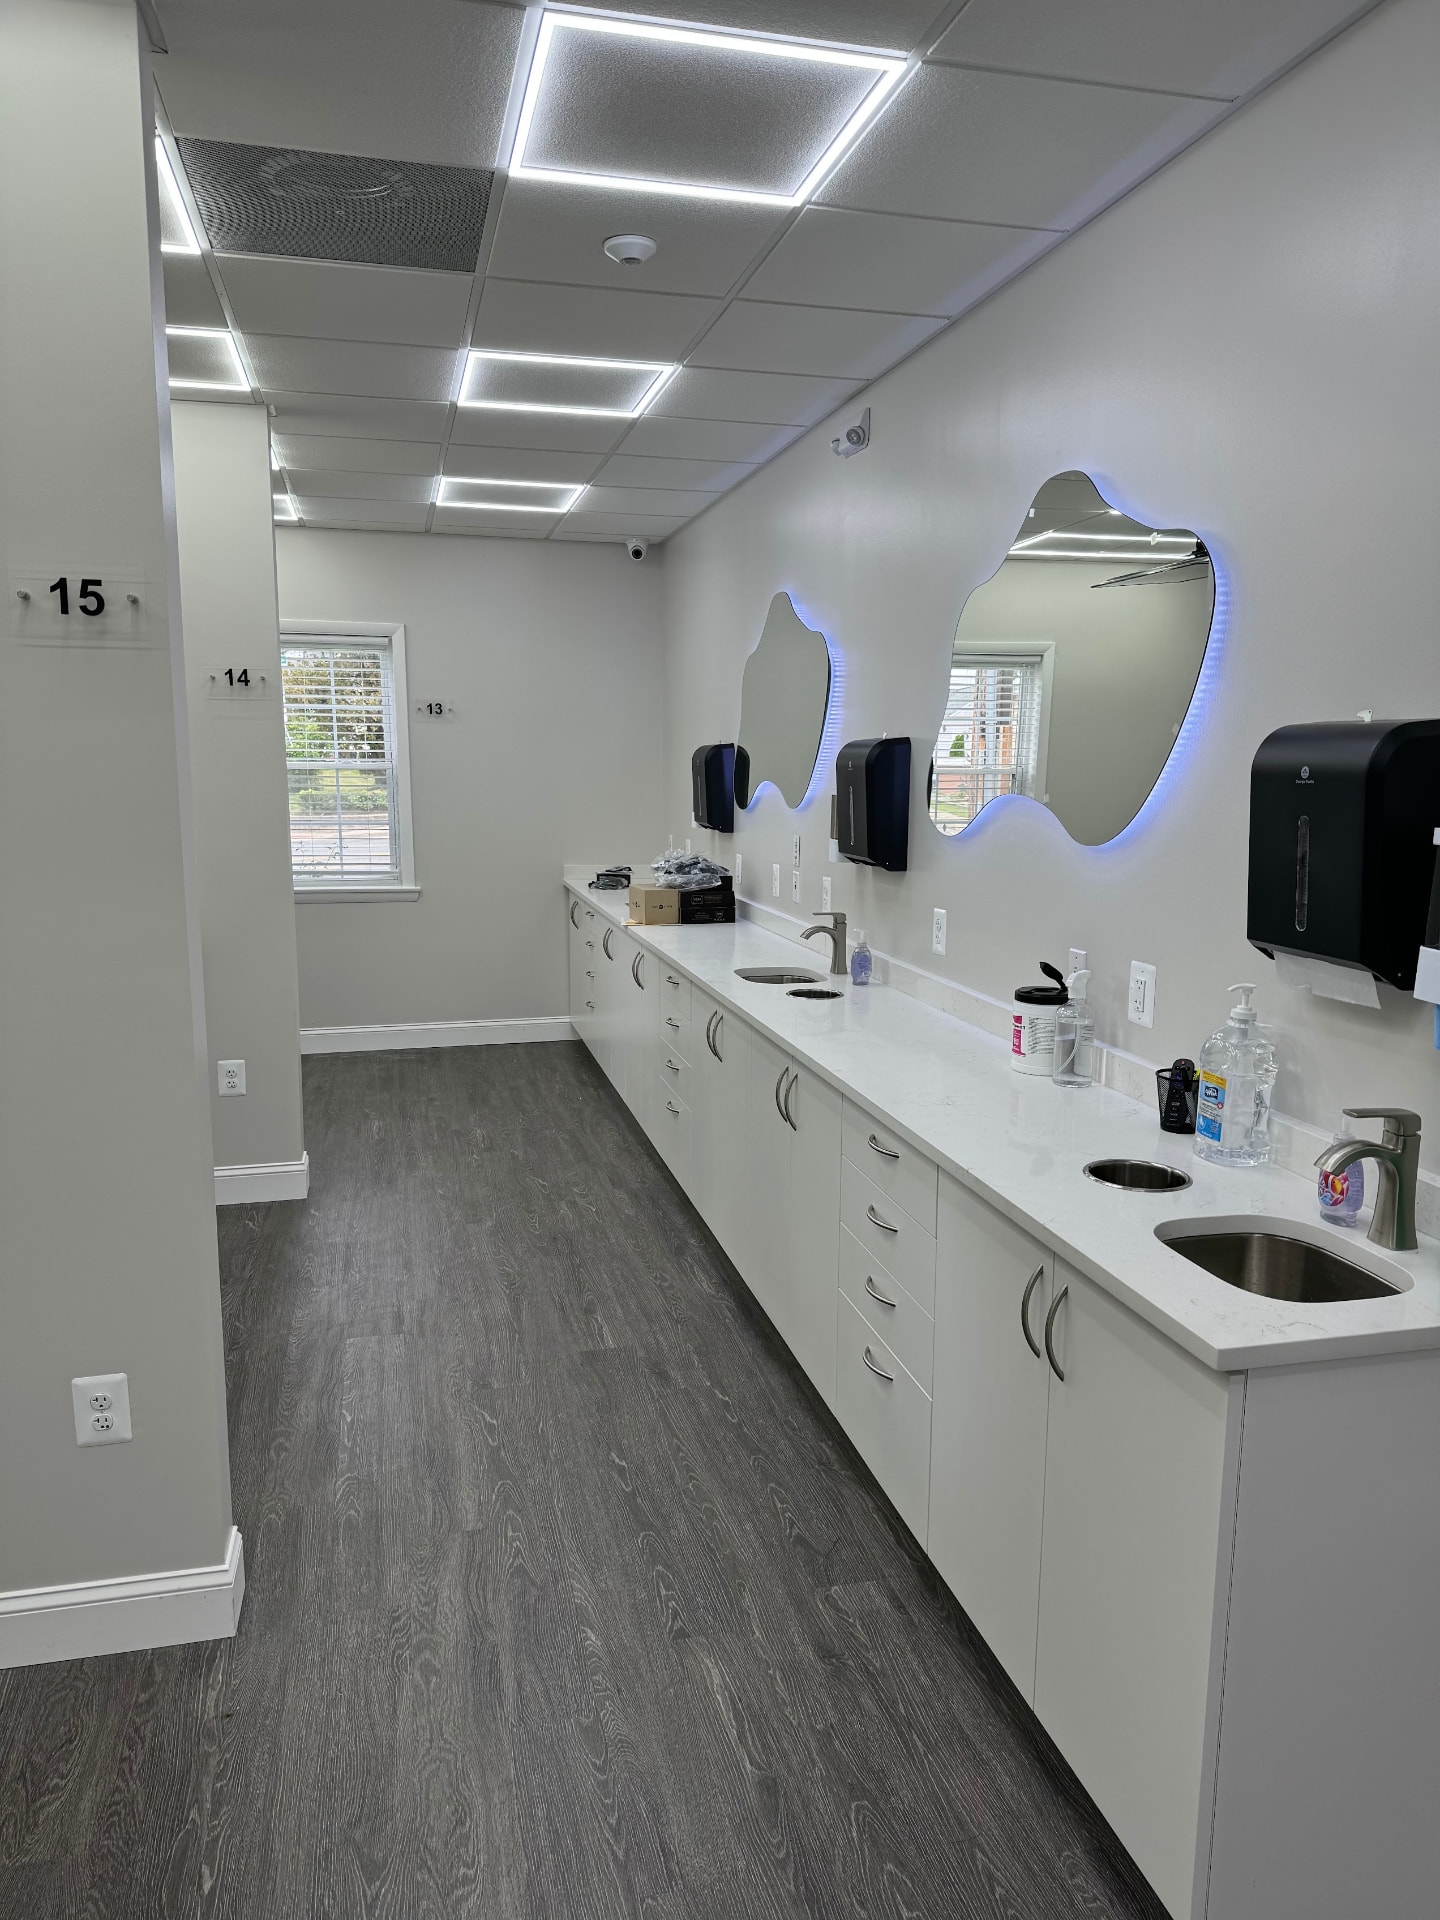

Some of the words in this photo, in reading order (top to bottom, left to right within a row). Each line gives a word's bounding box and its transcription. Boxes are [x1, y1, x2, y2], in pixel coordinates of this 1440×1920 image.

[49, 577, 105, 616] 15
[224, 668, 251, 687] 14
[426, 702, 443, 715] 13
